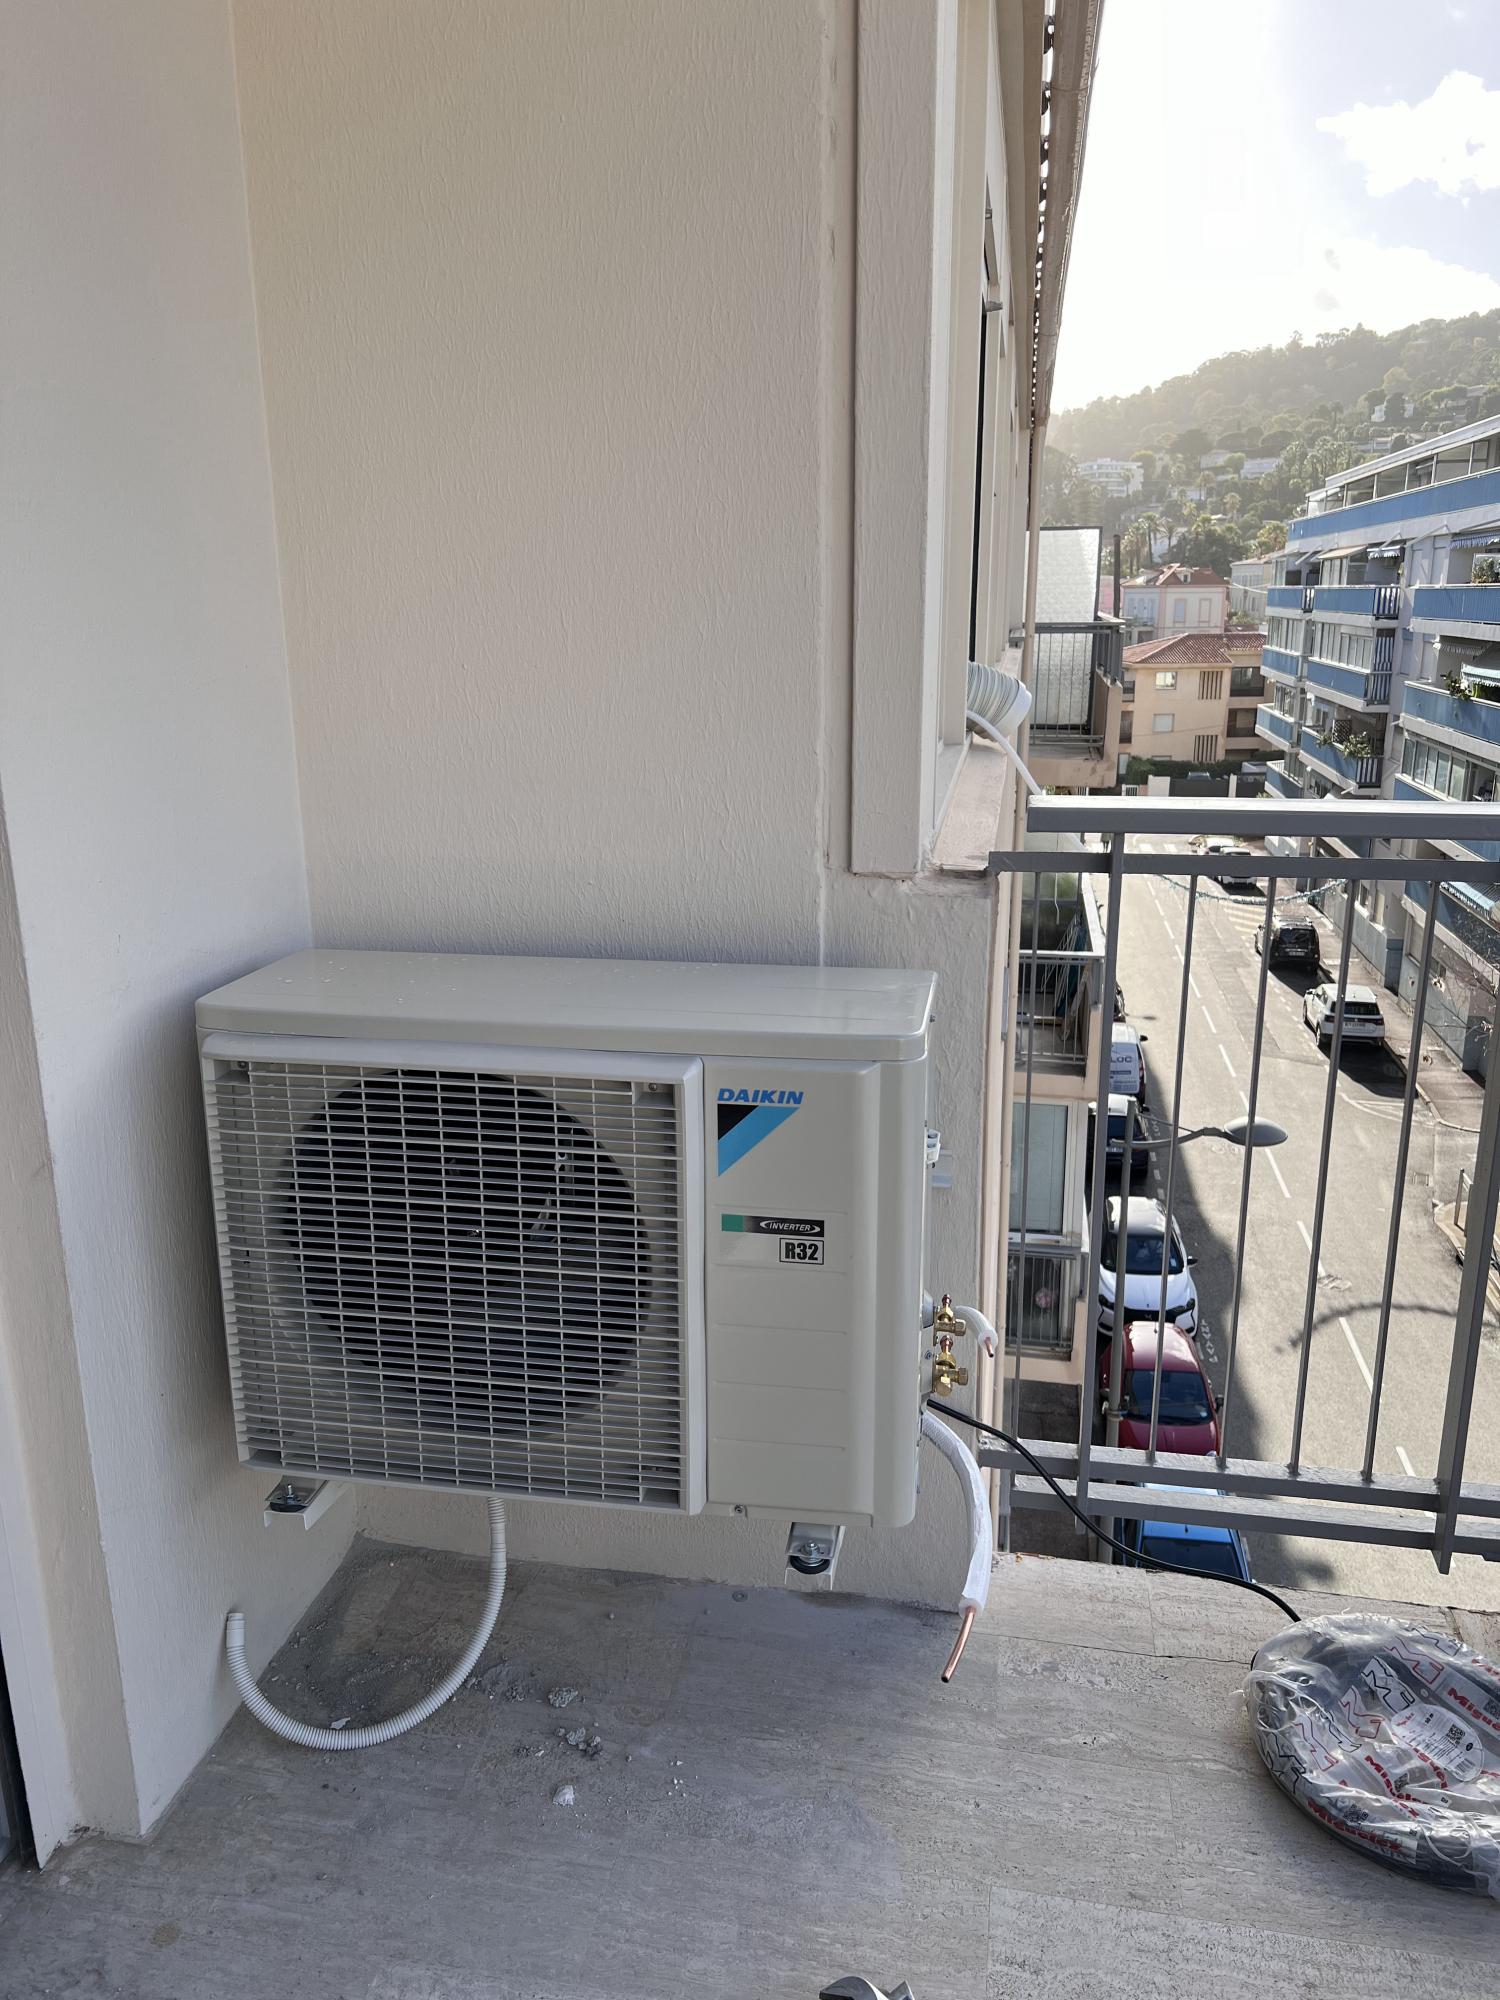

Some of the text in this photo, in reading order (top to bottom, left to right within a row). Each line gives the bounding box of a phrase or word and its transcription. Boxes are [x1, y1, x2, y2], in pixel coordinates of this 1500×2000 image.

[717, 1088, 804, 1105] DAIKIN
[769, 1221, 812, 1231] INVERTER
[784, 1242, 819, 1261] R32
